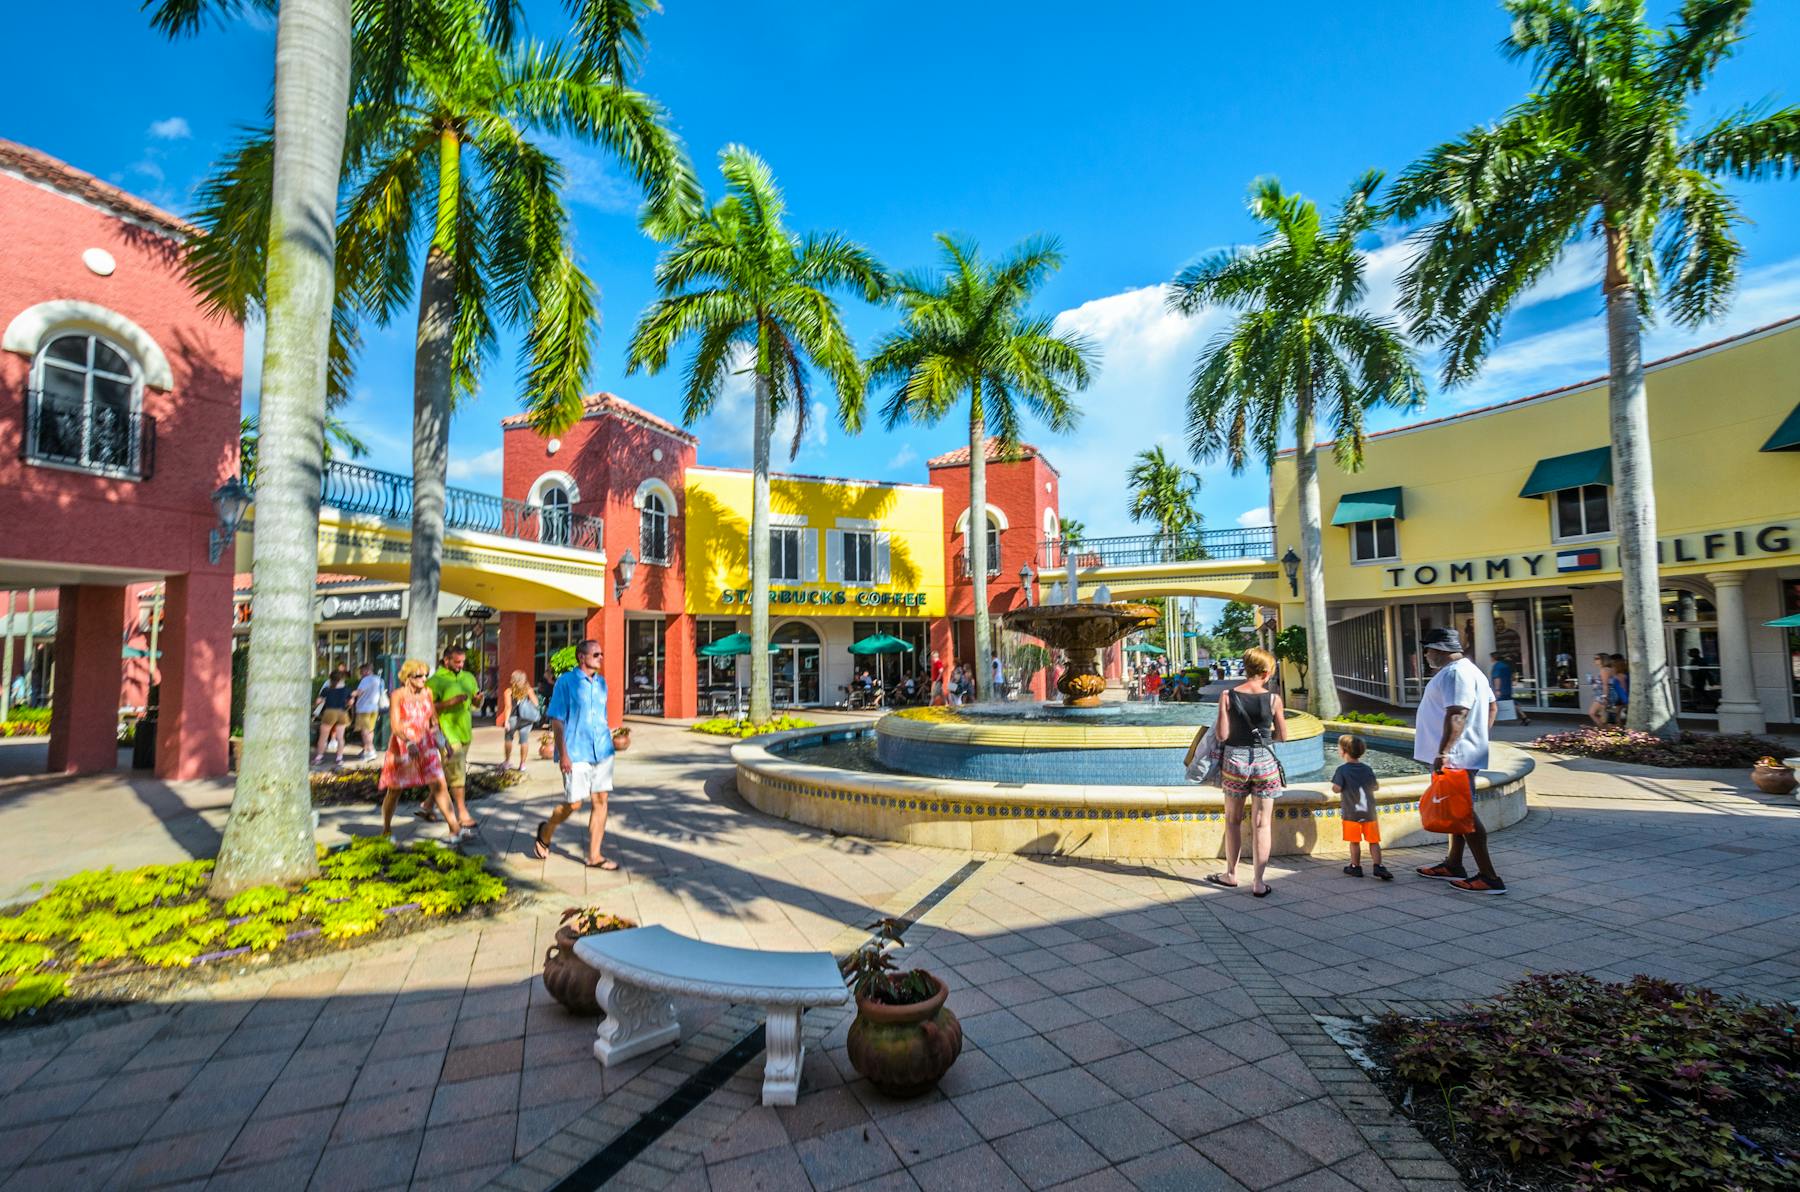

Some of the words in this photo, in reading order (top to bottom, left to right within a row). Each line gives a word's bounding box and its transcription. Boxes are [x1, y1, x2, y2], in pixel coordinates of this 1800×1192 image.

[1386, 554, 1543, 587] TOMMY
[1617, 526, 1791, 568] ILFIG
[856, 591, 927, 606] COFFEE
